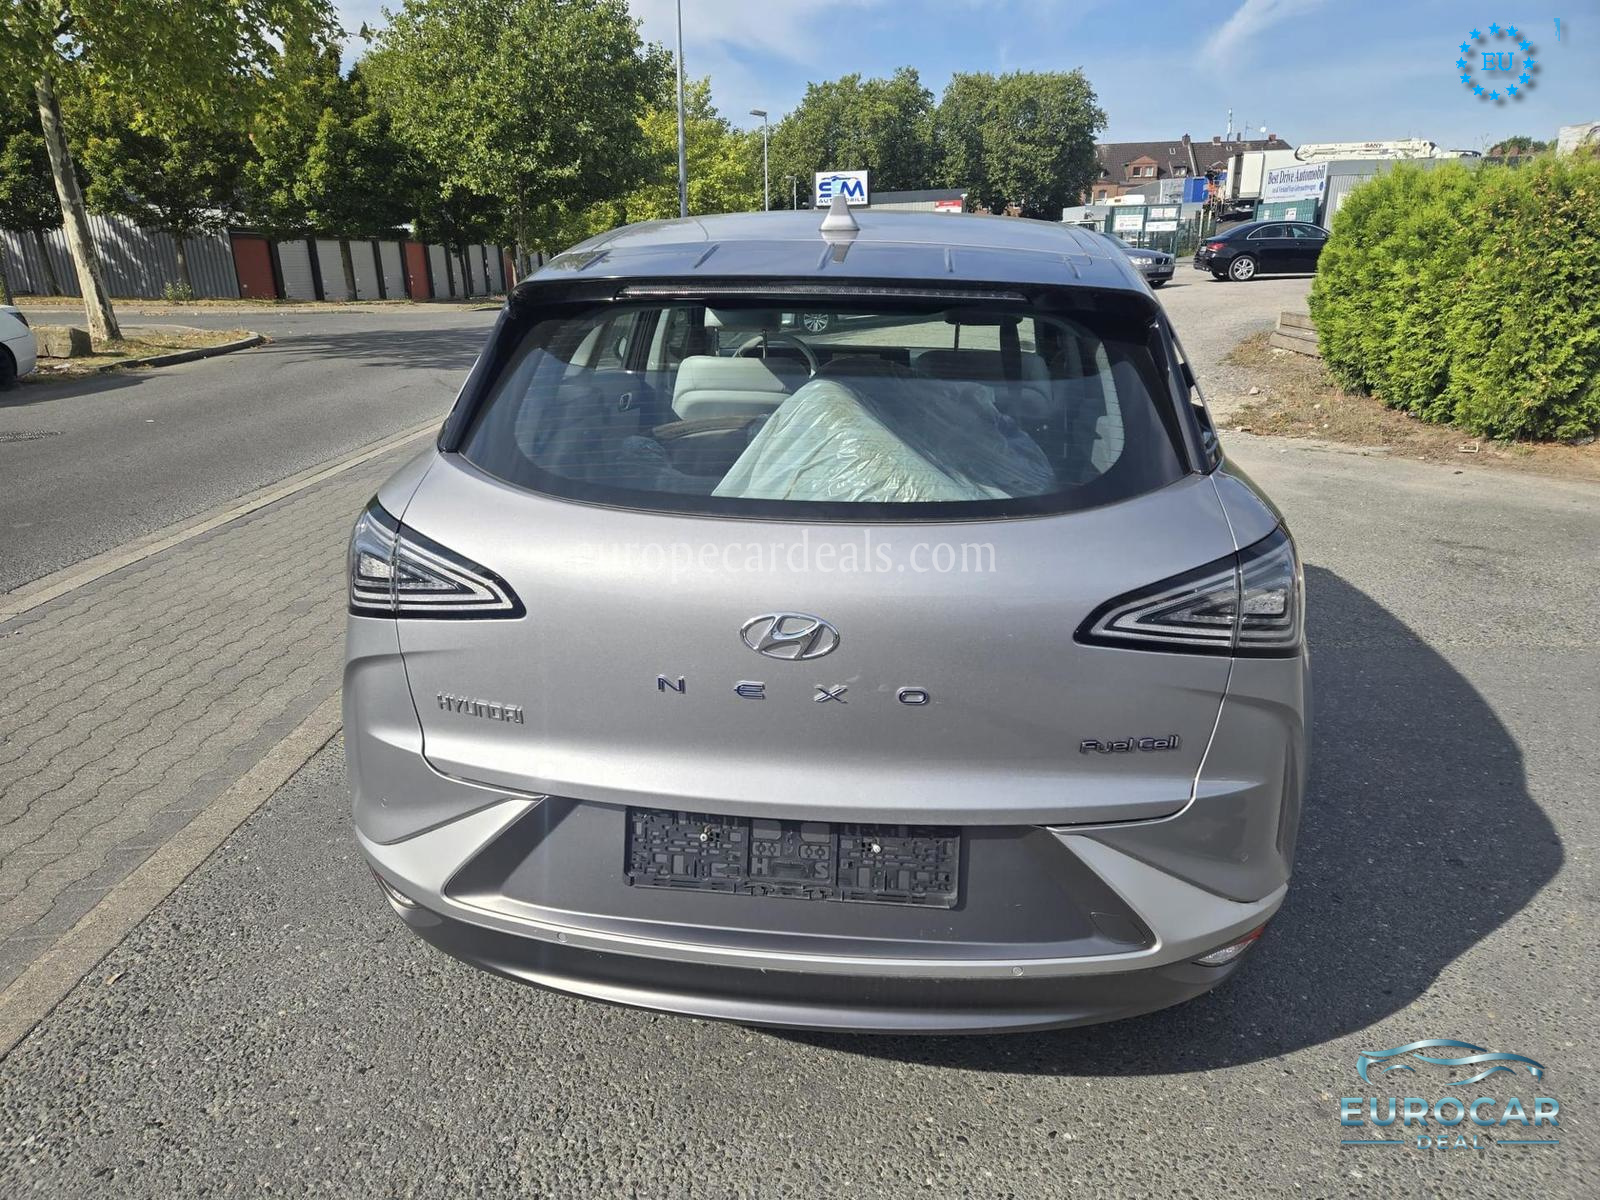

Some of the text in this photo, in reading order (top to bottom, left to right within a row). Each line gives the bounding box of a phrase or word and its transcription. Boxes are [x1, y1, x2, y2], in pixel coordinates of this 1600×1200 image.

[1268, 171, 1279, 185] Best
[1279, 169, 1295, 184] Drive
[656, 673, 929, 706] NEXO
[437, 691, 524, 725] HYUNDAI
[1080, 734, 1181, 755] Fuel Cell
